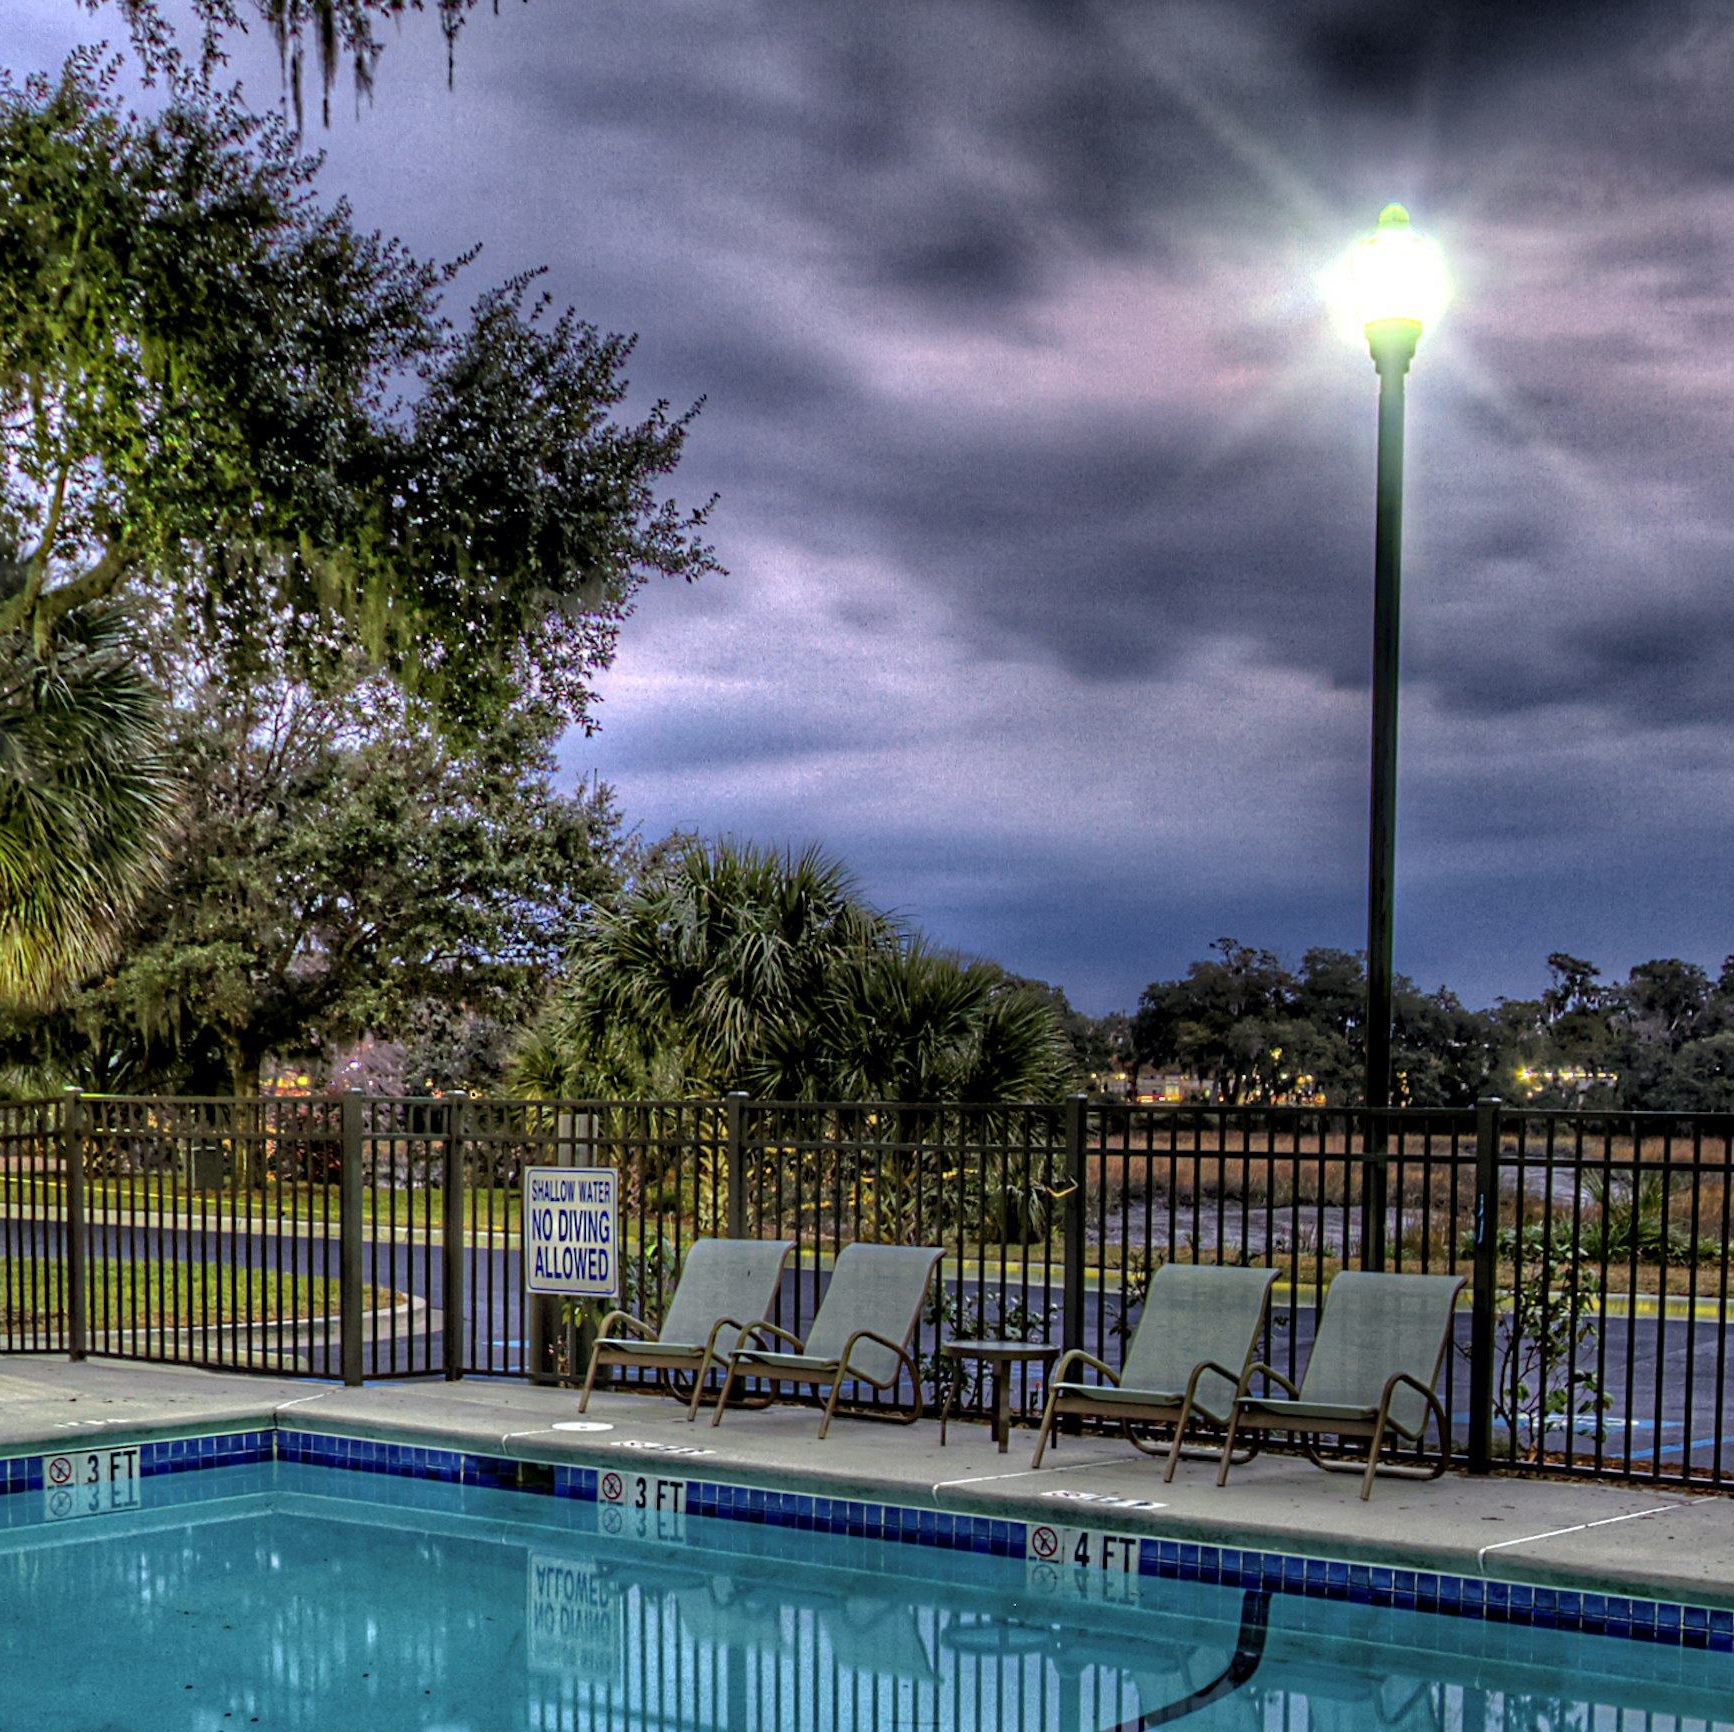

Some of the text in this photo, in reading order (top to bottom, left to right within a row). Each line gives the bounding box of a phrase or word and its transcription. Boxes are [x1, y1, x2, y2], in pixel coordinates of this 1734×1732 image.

[531, 1179, 611, 1204] SHALLOW WATER
[532, 1208, 610, 1244] NO DIVING
[535, 1246, 609, 1281] ALLOWED
[87, 1450, 137, 1484] 3 FT
[635, 1477, 683, 1513] 3 FT
[1074, 1532, 1136, 1573] 4 FT
